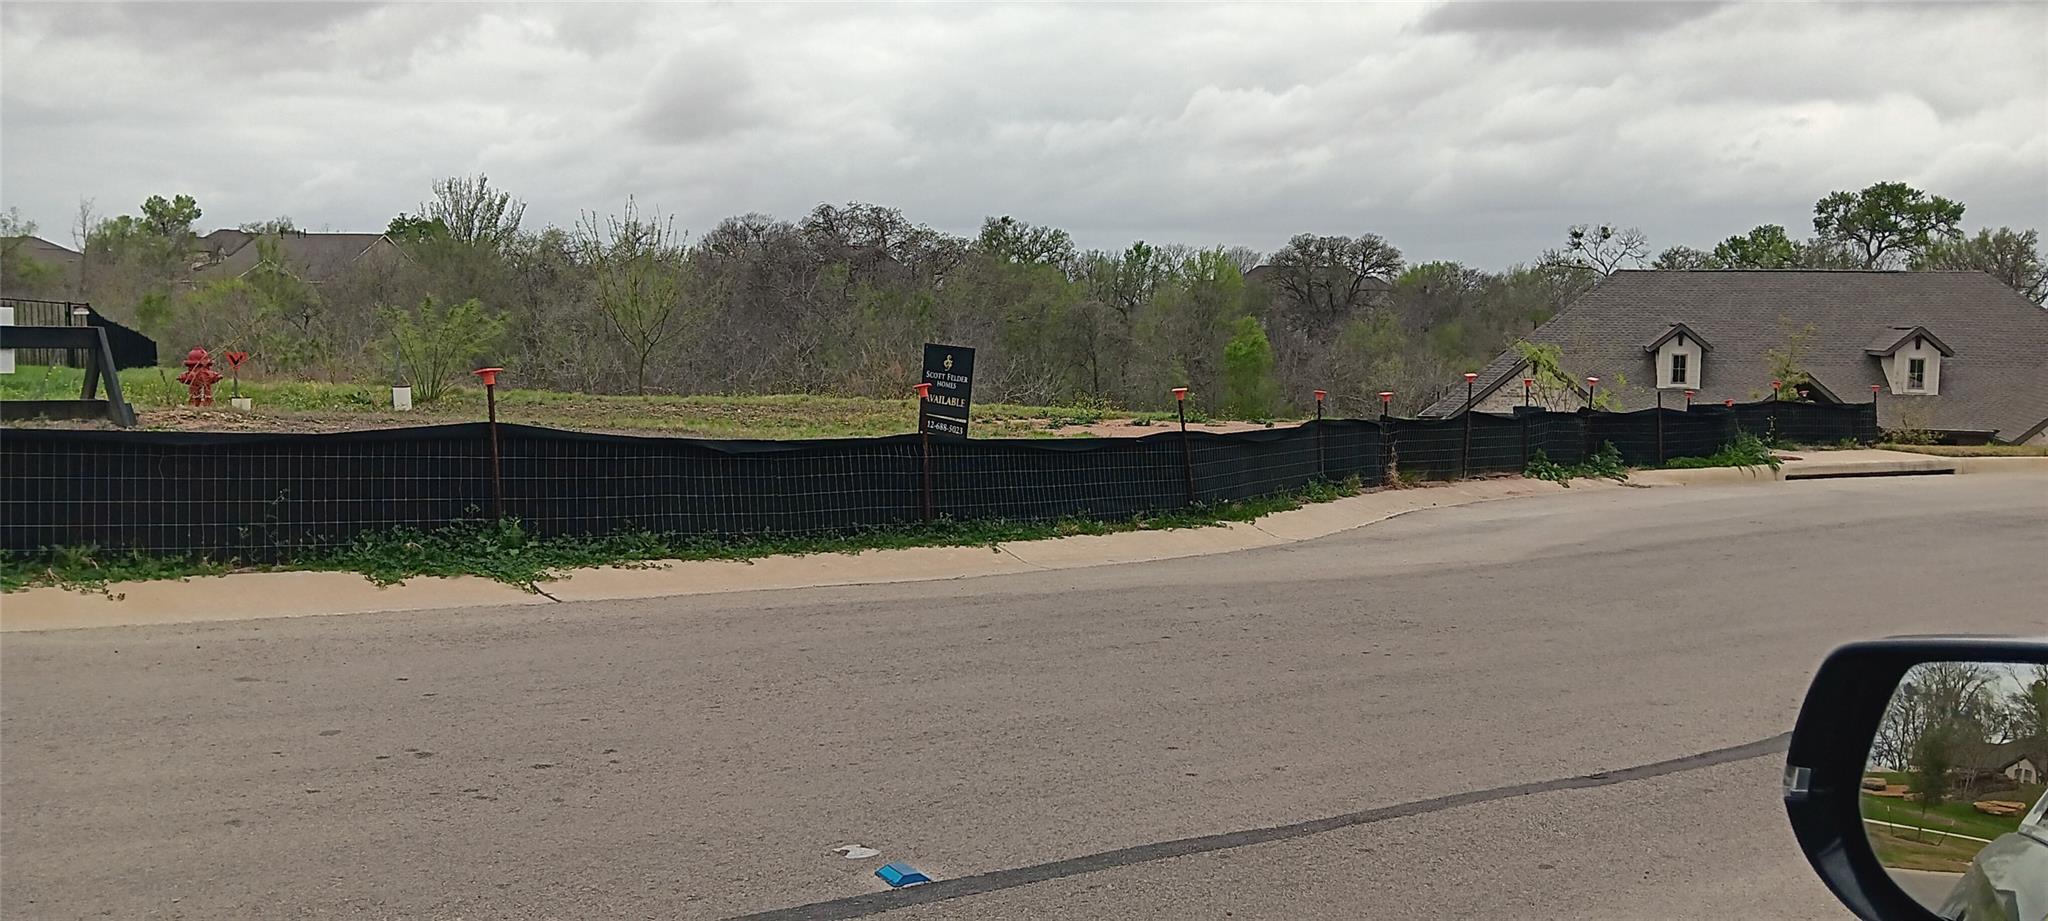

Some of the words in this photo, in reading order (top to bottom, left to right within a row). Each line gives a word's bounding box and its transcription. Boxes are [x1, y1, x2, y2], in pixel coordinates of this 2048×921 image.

[926, 370, 945, 380] SCOTT
[947, 373, 968, 383] FELDER
[937, 380, 957, 389] HOMES
[927, 420, 963, 434] 12-688-5023
